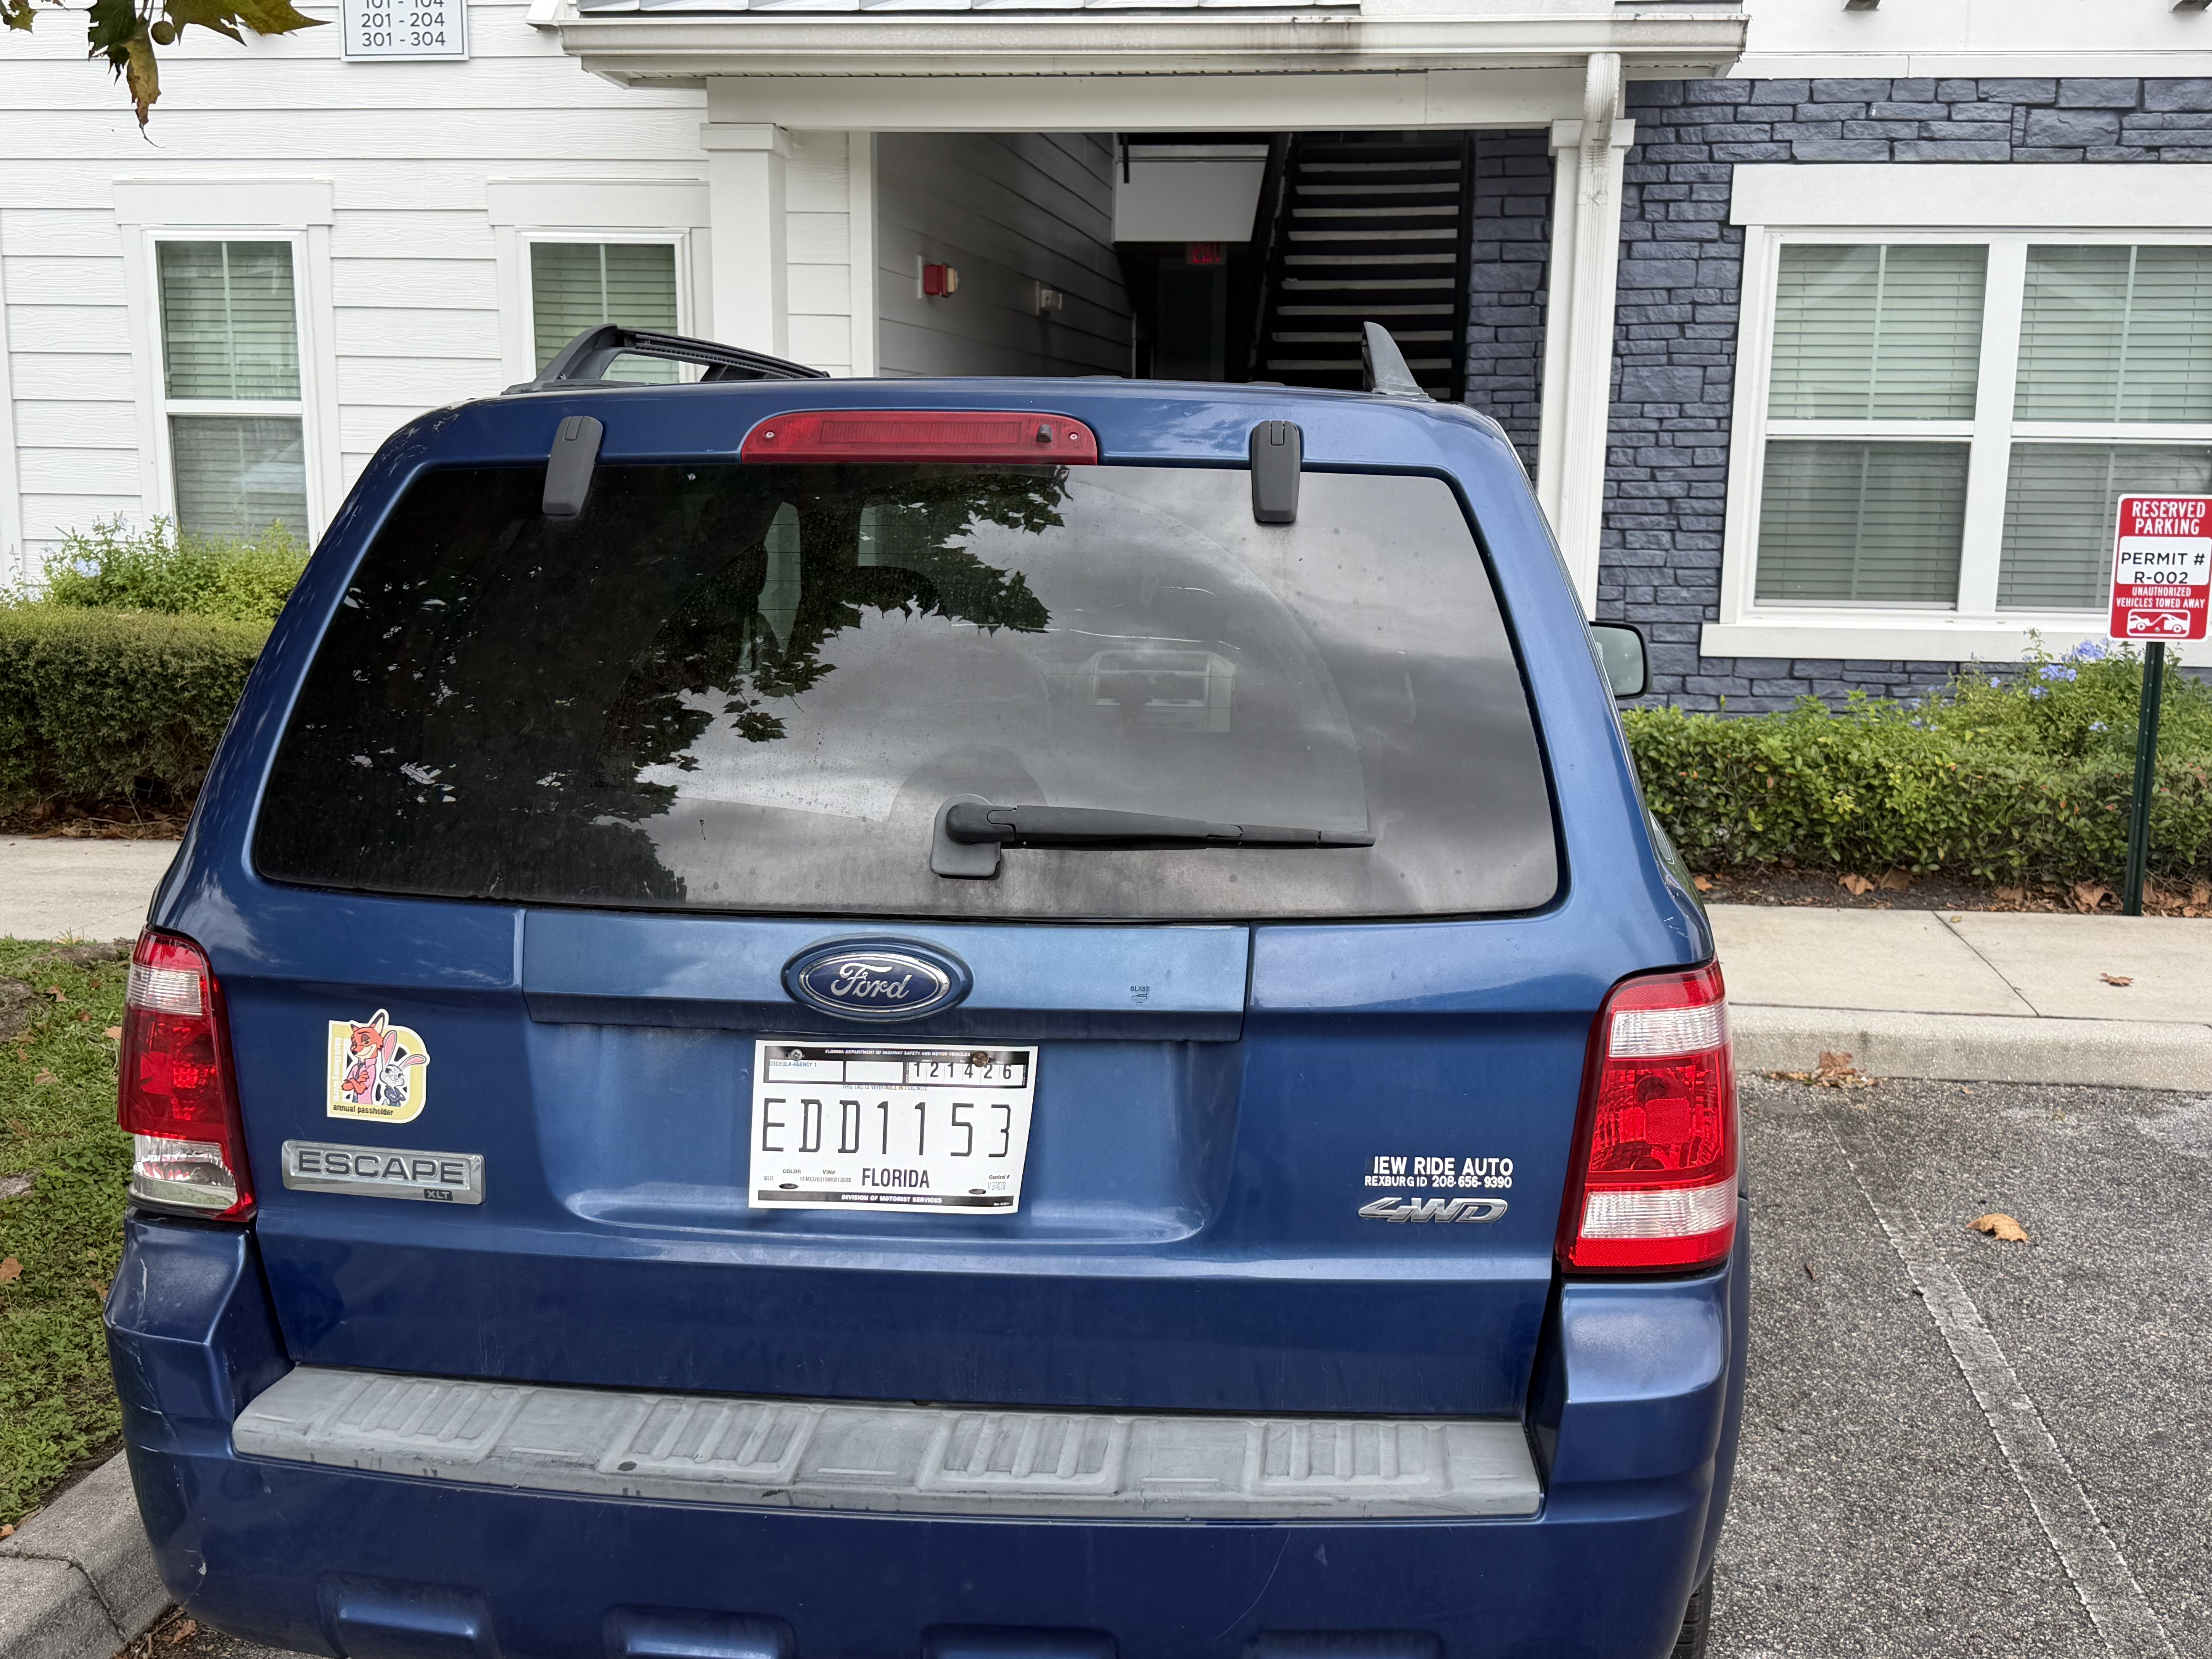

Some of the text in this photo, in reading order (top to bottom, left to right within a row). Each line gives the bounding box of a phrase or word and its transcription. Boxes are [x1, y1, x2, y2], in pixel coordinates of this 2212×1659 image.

[366, 0, 390, 9] 101
[361, 13, 391, 27] 201
[410, 12, 445, 27] 204
[362, 32, 392, 46] 301
[410, 31, 446, 46] 304
[2132, 501, 2206, 518] RESERVED
[2135, 519, 2200, 535] PARKING
[2121, 552, 2205, 565] PERMIT #
[2134, 571, 2188, 584] R-002
[2132, 586, 2191, 597] UNAUTHORIZED
[2116, 597, 2205, 608] VEHICLES TOWED AWAY
[831, 962, 912, 999] Ford
[333, 1104, 394, 1116] annual passholder
[762, 1098, 1011, 1158] EDD1153
[298, 1150, 465, 1184] ESCAPE
[1414, 1157, 1455, 1175] RIDE
[1462, 1158, 1514, 1176] AUTO
[862, 1168, 930, 1188] FLORIDA
[1364, 1175, 1414, 1187] REXBURG
[1417, 1176, 1428, 1187] ID
[427, 1190, 451, 1199] XLT
[1358, 1197, 1508, 1223] 4WD
